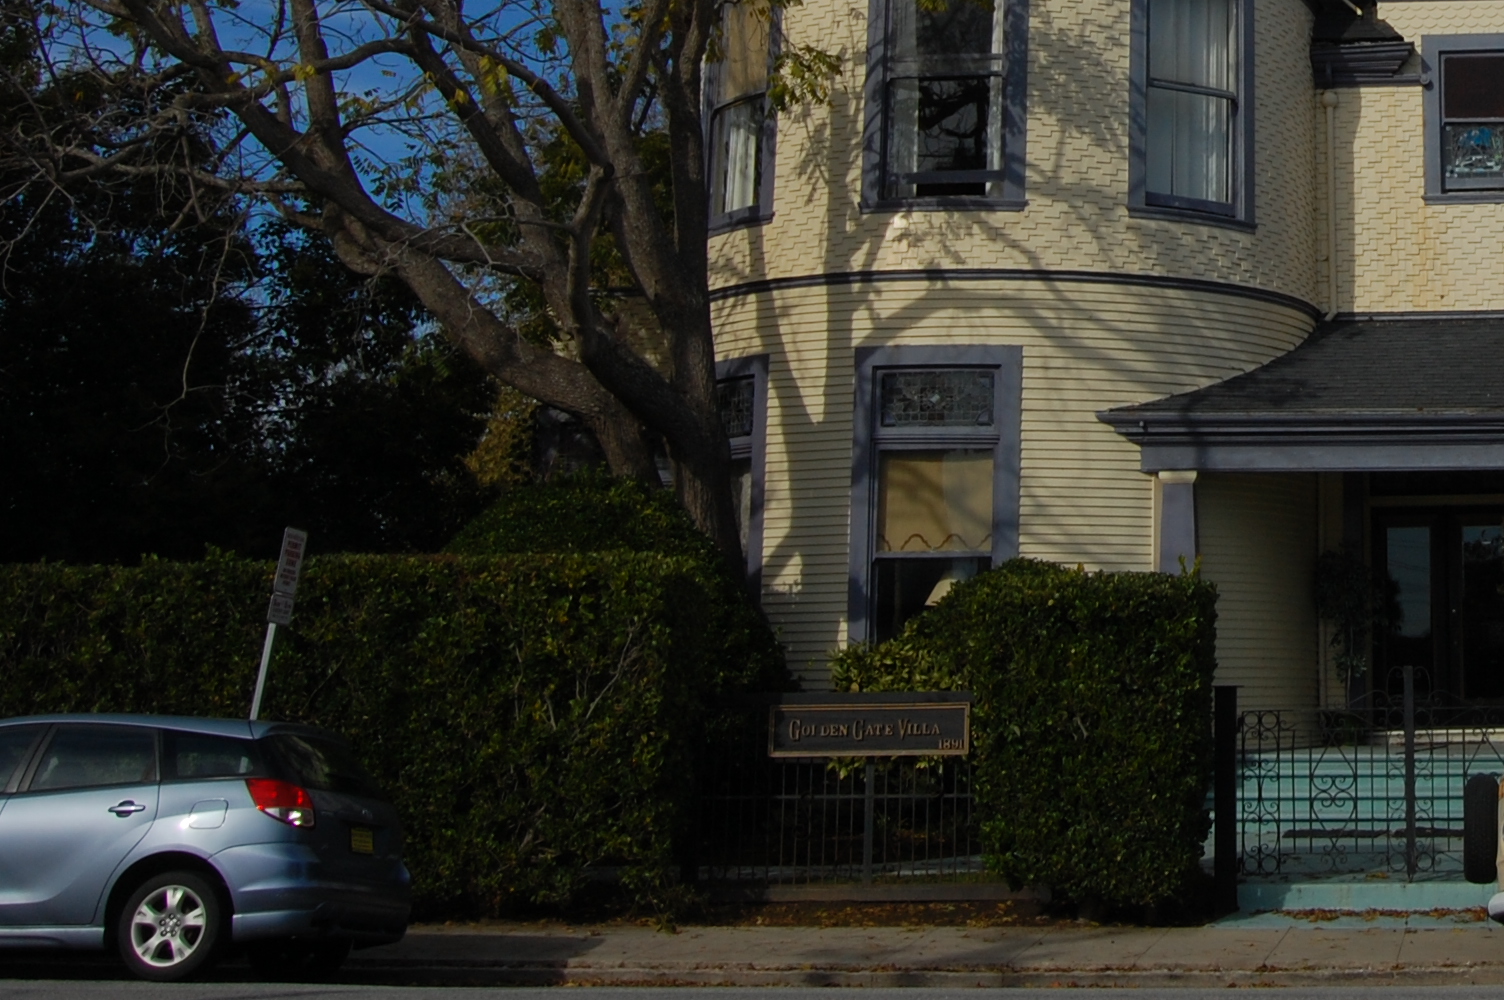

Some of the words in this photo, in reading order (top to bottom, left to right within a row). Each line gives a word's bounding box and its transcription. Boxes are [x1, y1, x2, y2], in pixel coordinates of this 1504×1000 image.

[852, 719, 894, 741] GATE
[898, 718, 940, 740] VILLA
[938, 739, 964, 750] 1891
